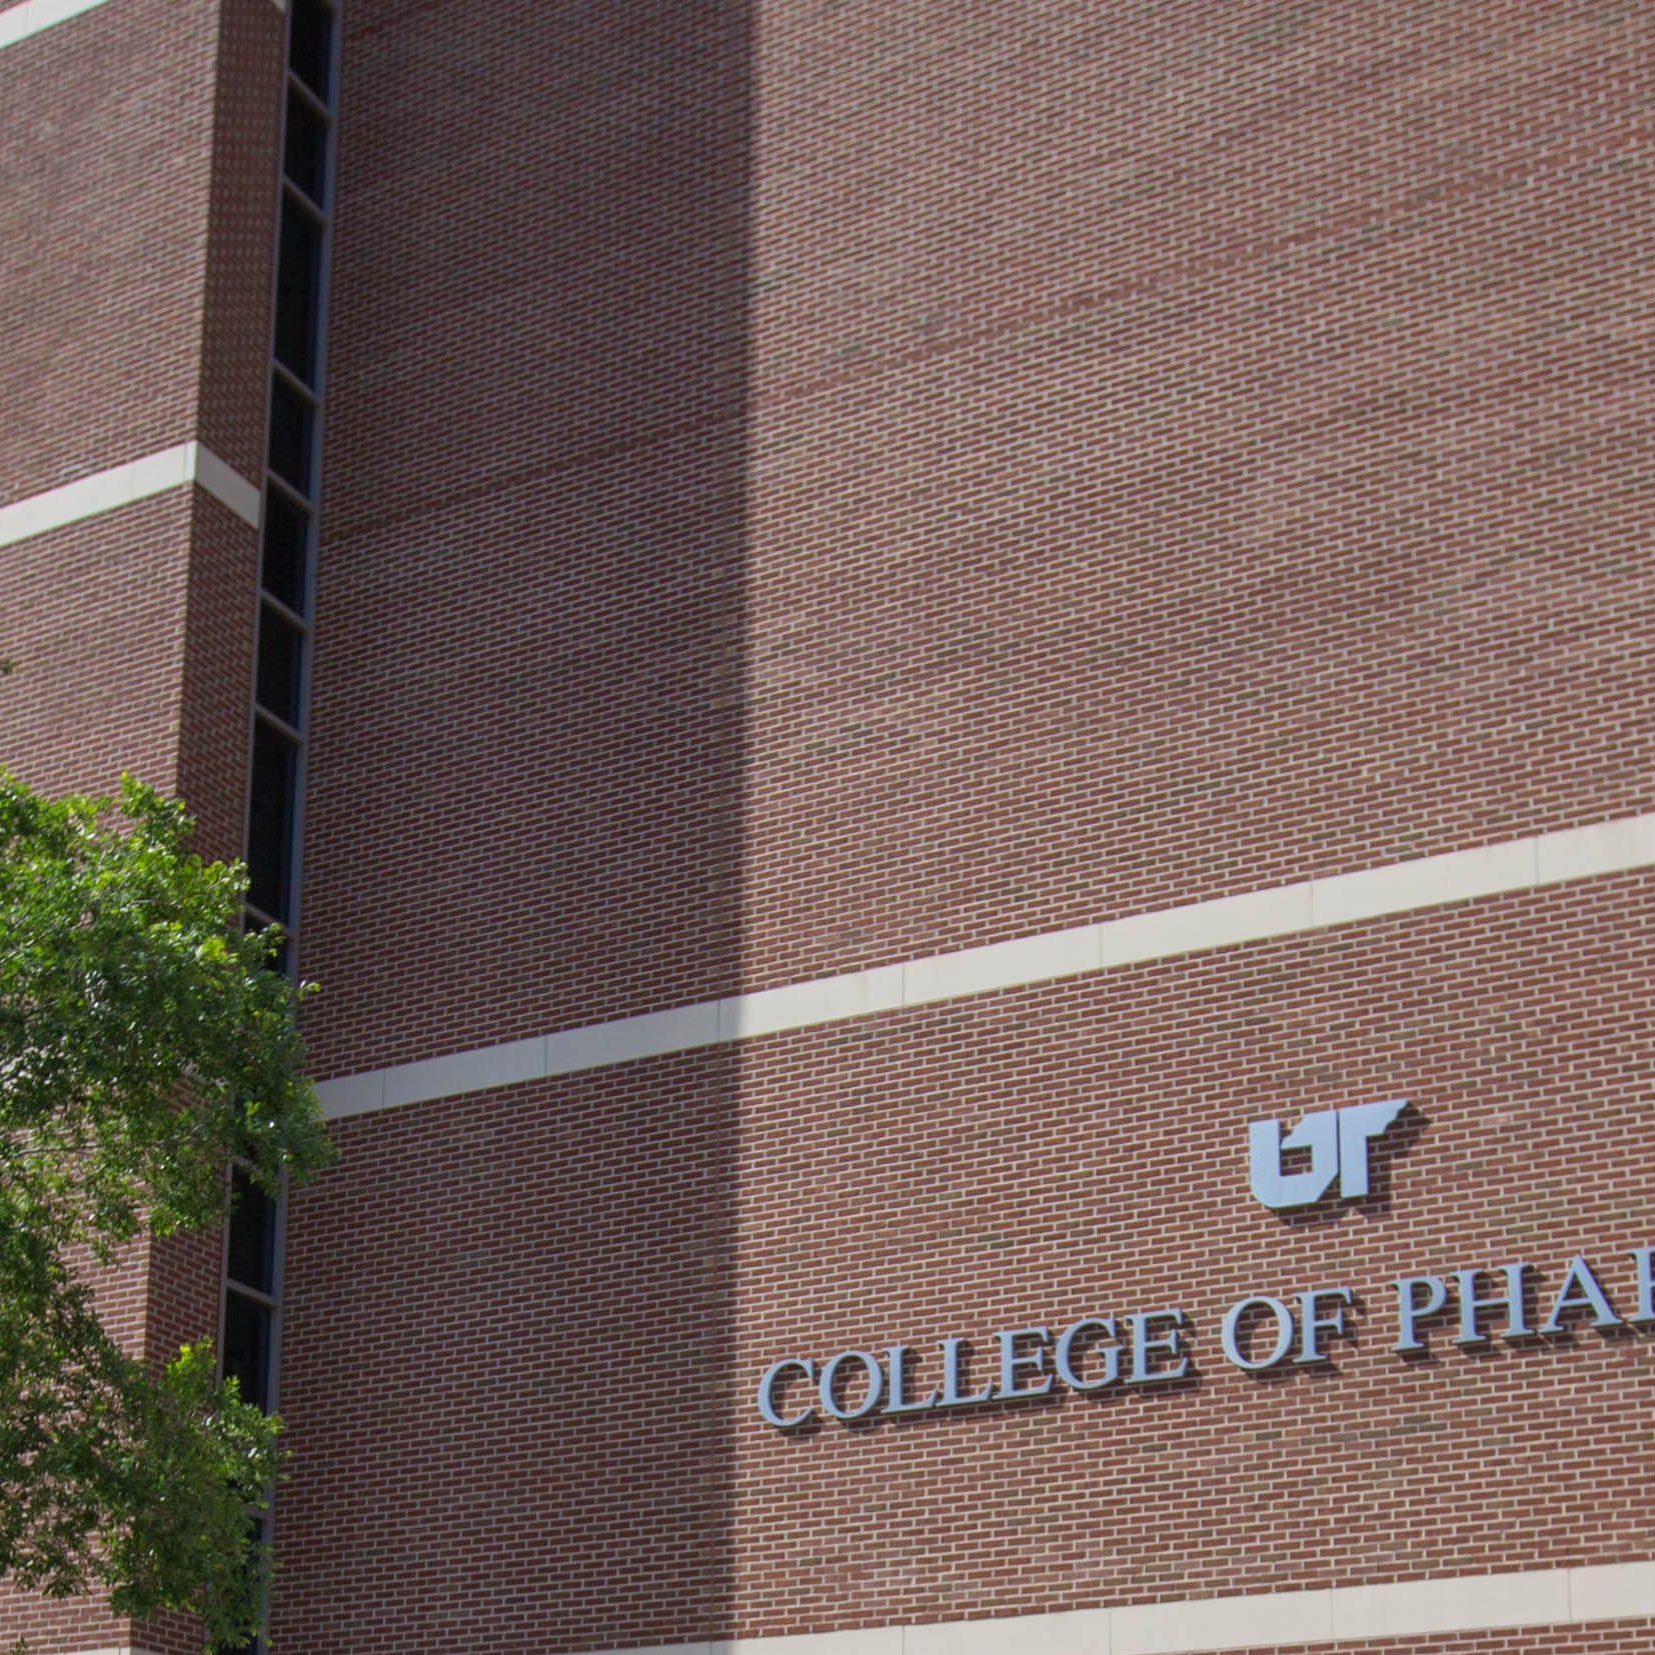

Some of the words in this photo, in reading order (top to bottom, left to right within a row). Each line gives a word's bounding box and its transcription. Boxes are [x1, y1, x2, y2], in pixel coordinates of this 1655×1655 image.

[1249, 1099, 1409, 1208] UT
[757, 1308, 1189, 1428] COLLEGE
[1221, 1286, 1353, 1371] OF
